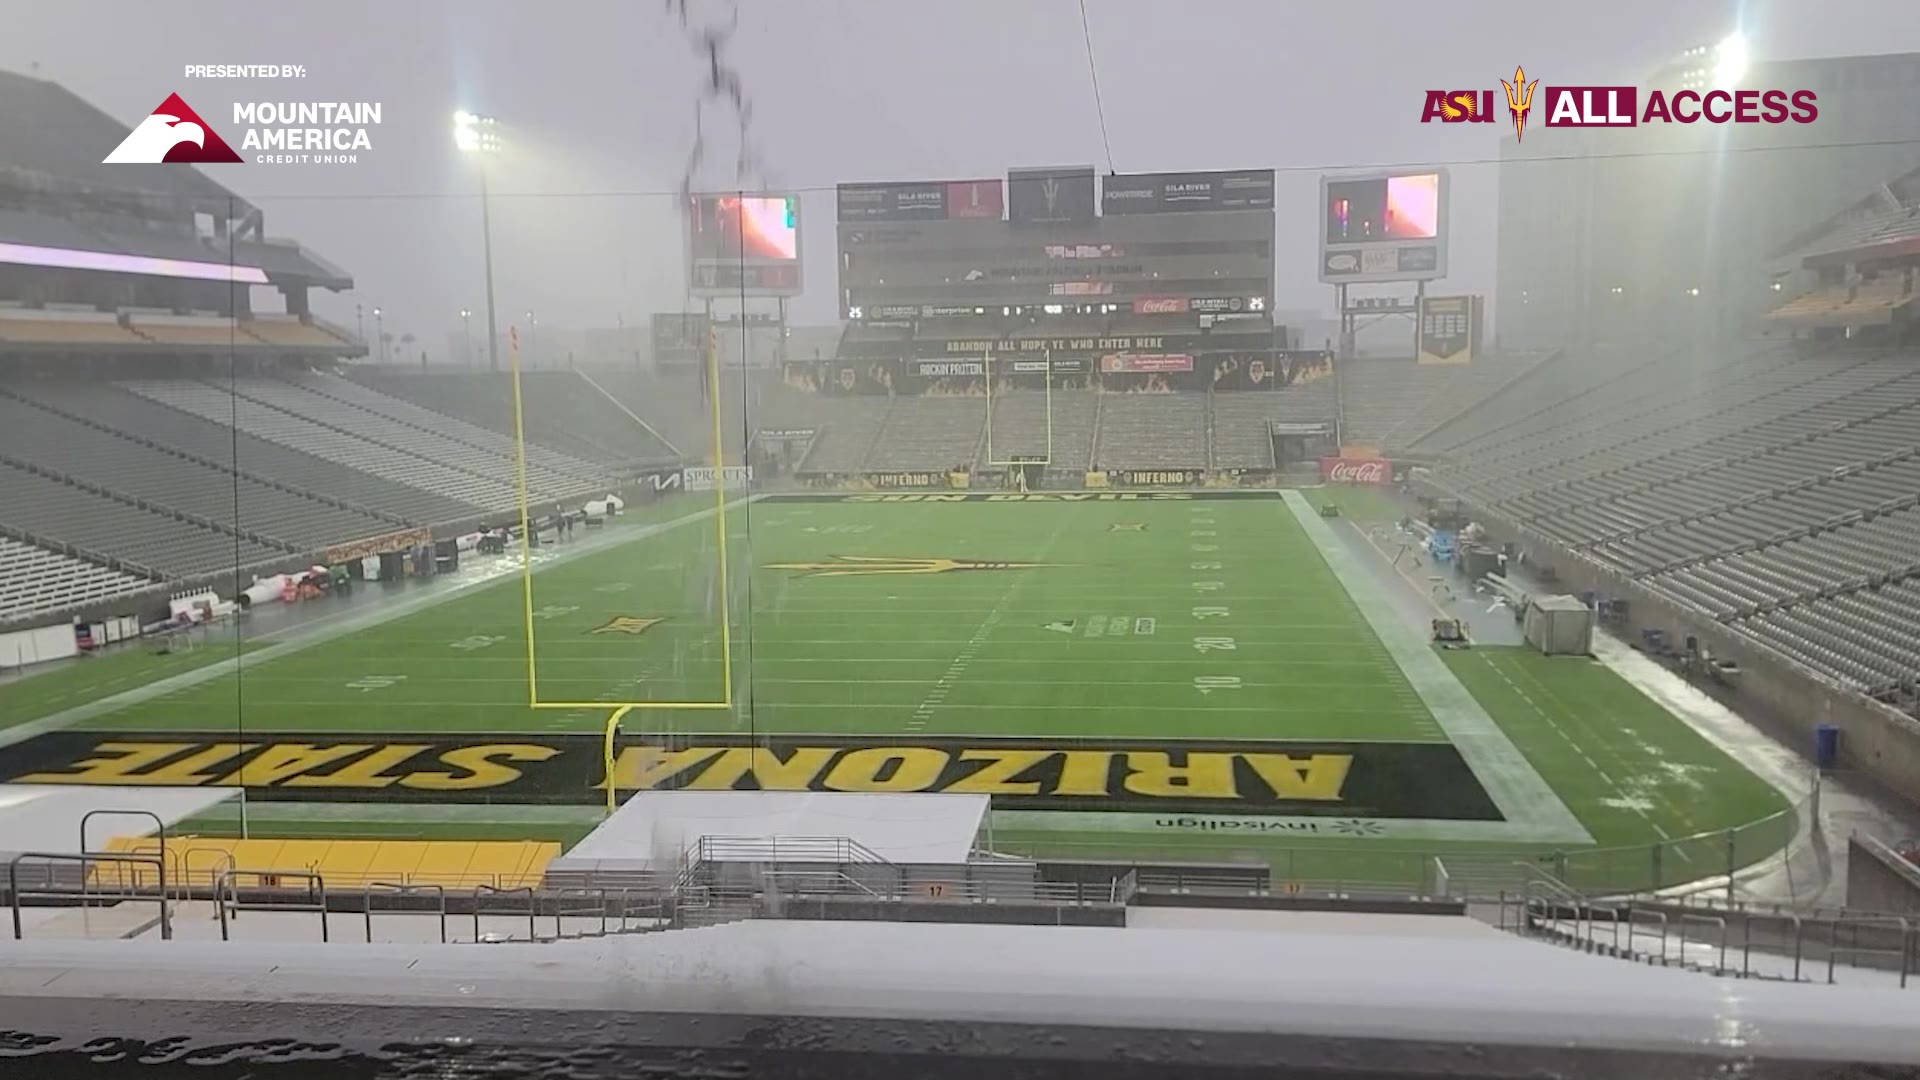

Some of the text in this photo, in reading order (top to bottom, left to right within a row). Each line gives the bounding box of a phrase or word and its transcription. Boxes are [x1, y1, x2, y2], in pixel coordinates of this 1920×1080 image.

[947, 341, 993, 351] ABANDON
[998, 341, 1015, 351] ALL
[1053, 340, 1064, 349] YE
[1070, 339, 1094, 349] WHO
[1099, 339, 1131, 348] ENTER
[1136, 338, 1163, 348] HERE
[1133, 472, 1184, 484] INFERNO
[24, 741, 1355, 801] ARIZONA STATE
[1155, 817, 1318, 834] invisalign
[264, 874, 277, 887] 18
[930, 886, 942, 897] 17
